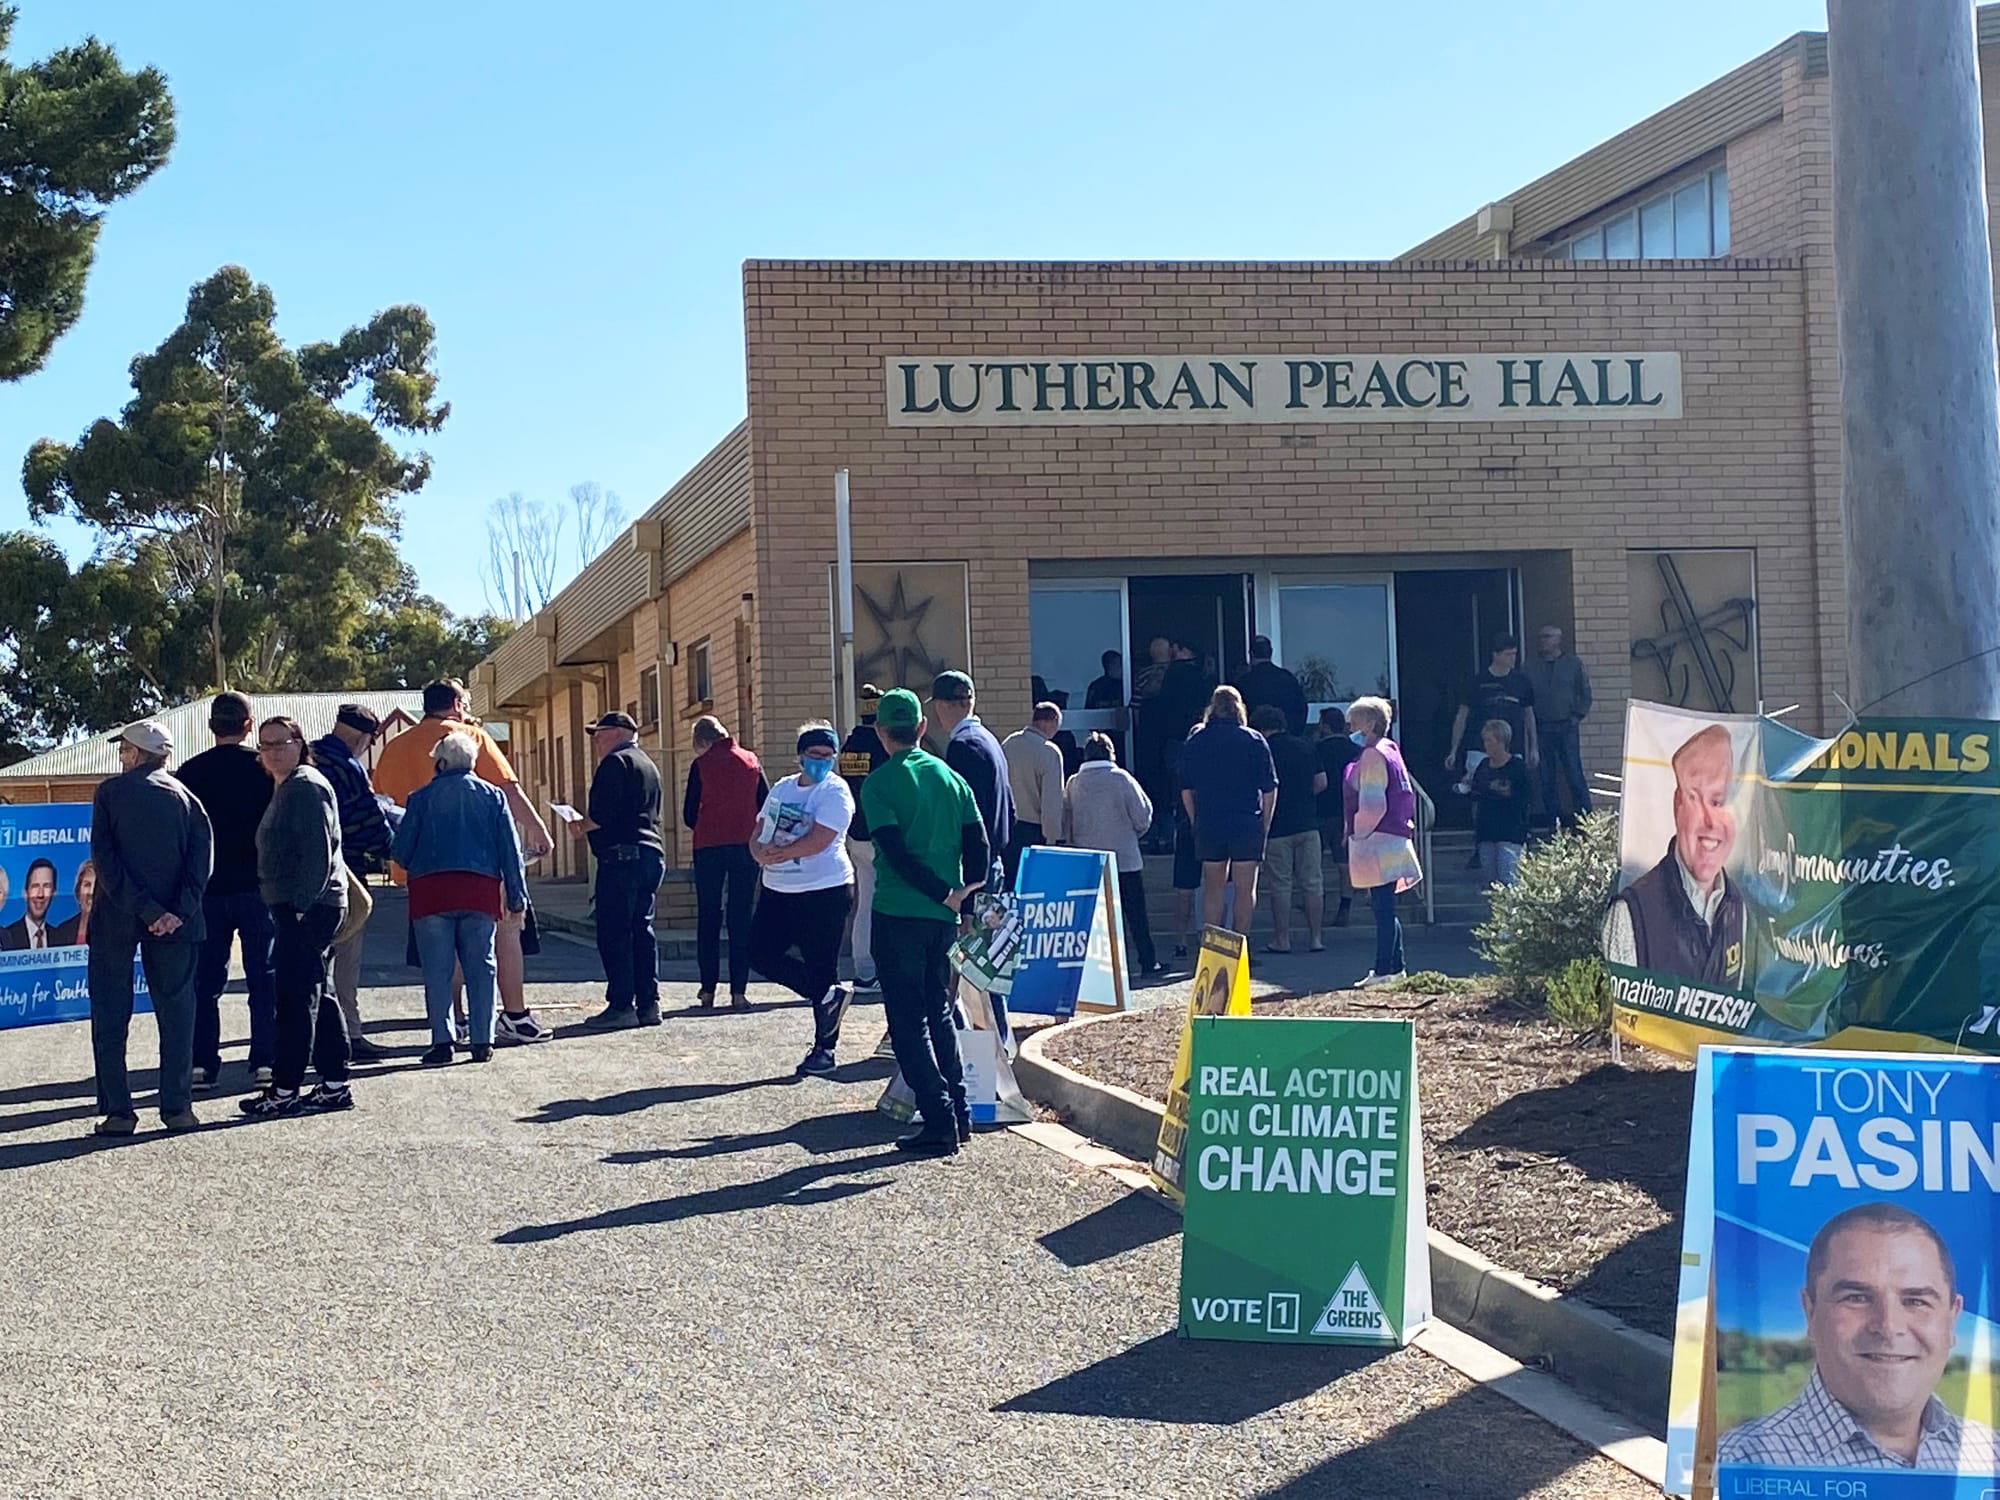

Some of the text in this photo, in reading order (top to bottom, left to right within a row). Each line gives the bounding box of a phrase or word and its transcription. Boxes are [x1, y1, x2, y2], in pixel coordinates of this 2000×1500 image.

[898, 358, 1663, 413] LUTHERAN PEACE HALL
[18, 828, 75, 846] LIBERAL
[1023, 901, 1075, 929] PASIN
[63, 950, 82, 962] THE
[32, 982, 50, 1012] for
[1610, 975, 1674, 1011] onathan
[1674, 985, 1757, 1029] PIETZSCH
[1200, 1066, 1401, 1099] REAL ACTION
[1801, 1067, 1951, 1115] TONY
[1201, 1103, 1397, 1139] ON CLIMATE
[1198, 1145, 1397, 1196] CHANGE
[1191, 1297, 1288, 1324] VOTE 1
[1342, 1290, 1368, 1308] THE
[1327, 1309, 1382, 1329] GREENS
[1734, 1477, 1867, 1499] LIBERAL FOR
